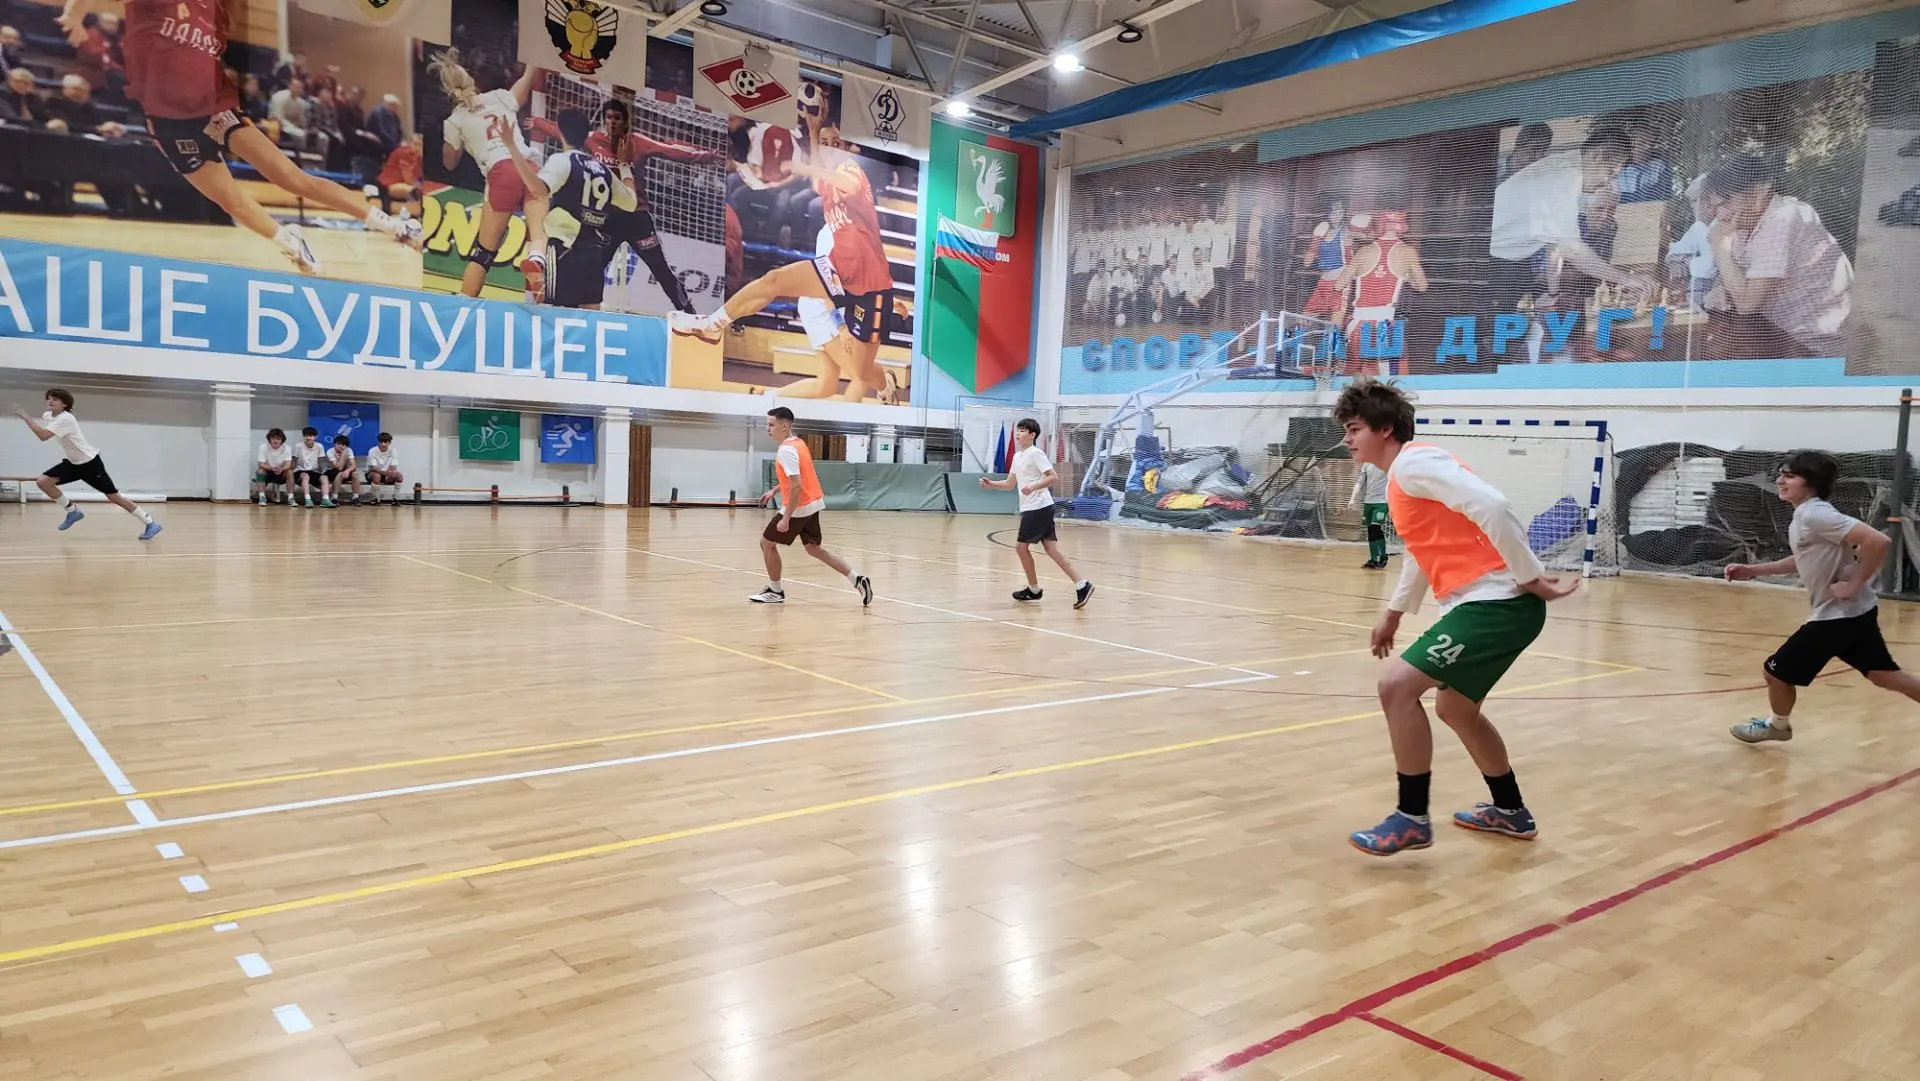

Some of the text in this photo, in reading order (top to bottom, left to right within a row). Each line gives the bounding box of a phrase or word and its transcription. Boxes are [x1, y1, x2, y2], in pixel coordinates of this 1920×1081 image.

[581, 170, 610, 211] 19
[247, 280, 629, 384] БУДУЩЕЕ
[1081, 330, 1238, 373] СПОРТ
[1435, 306, 1668, 364] ДРУГ!
[1426, 633, 1466, 665] 24
